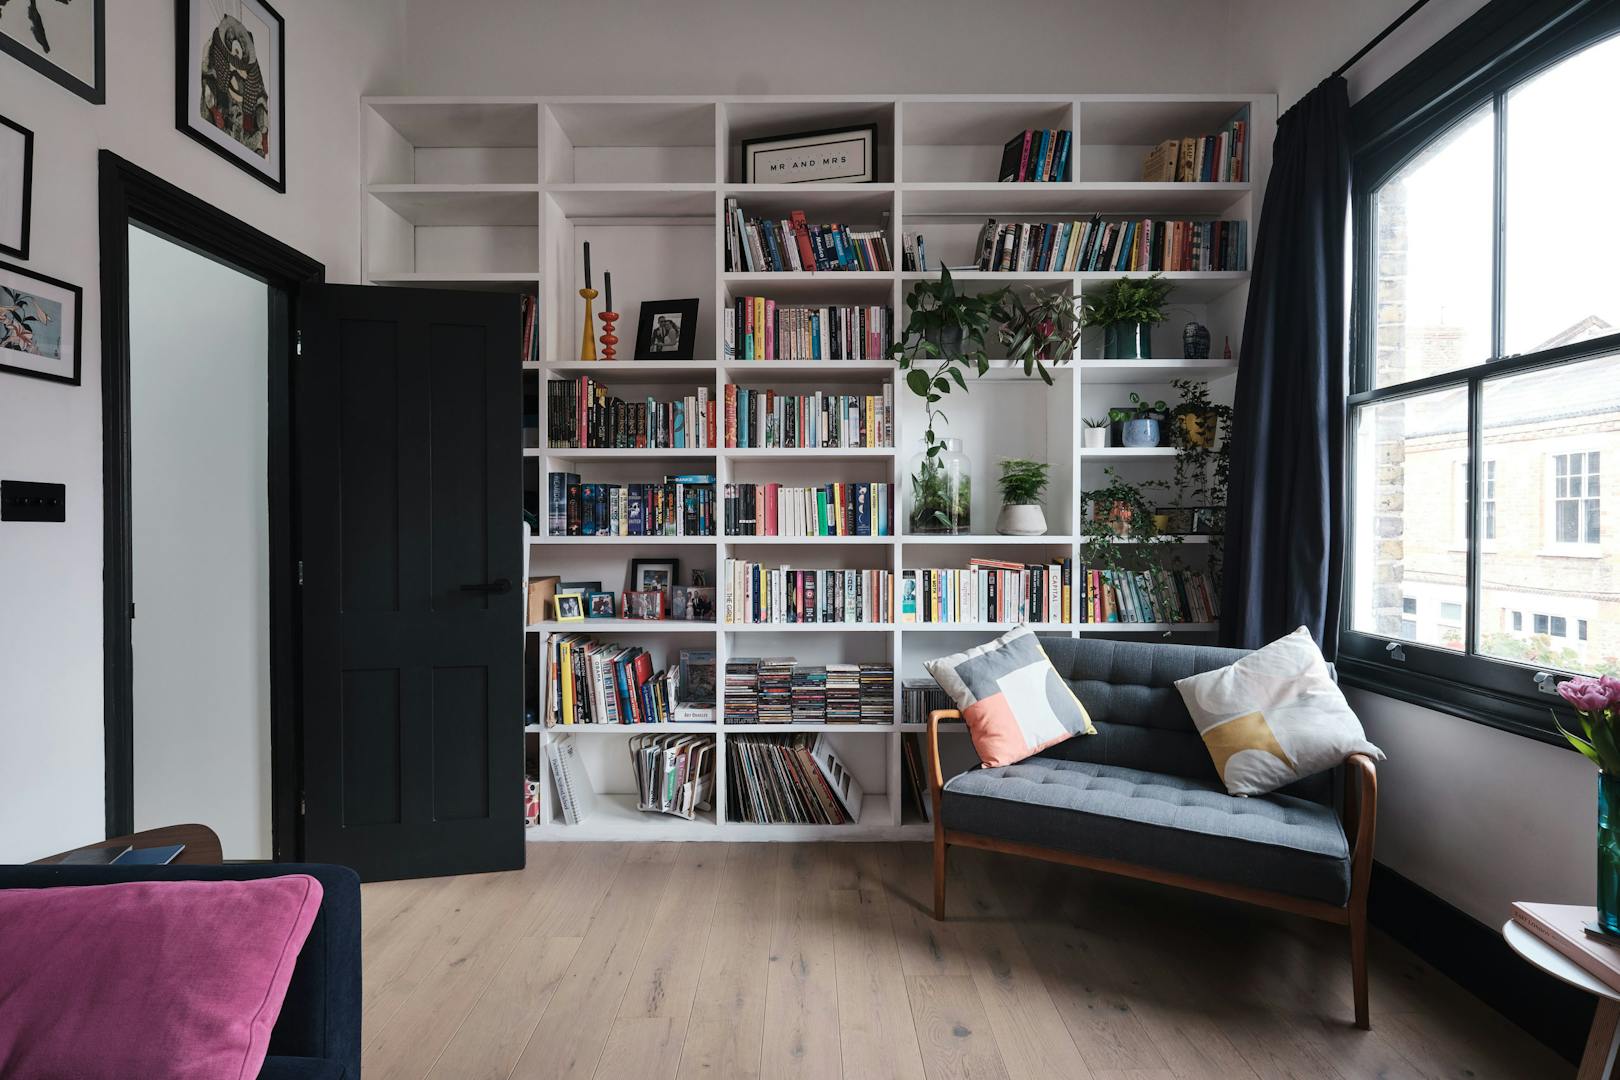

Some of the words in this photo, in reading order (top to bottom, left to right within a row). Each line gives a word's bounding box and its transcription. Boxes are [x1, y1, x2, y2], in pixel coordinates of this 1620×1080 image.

[770, 163, 785, 171] MR
[792, 160, 816, 168] AND
[822, 156, 847, 165] MRS
[815, 236, 825, 258] Mexico
[594, 661, 602, 682] OBAMA
